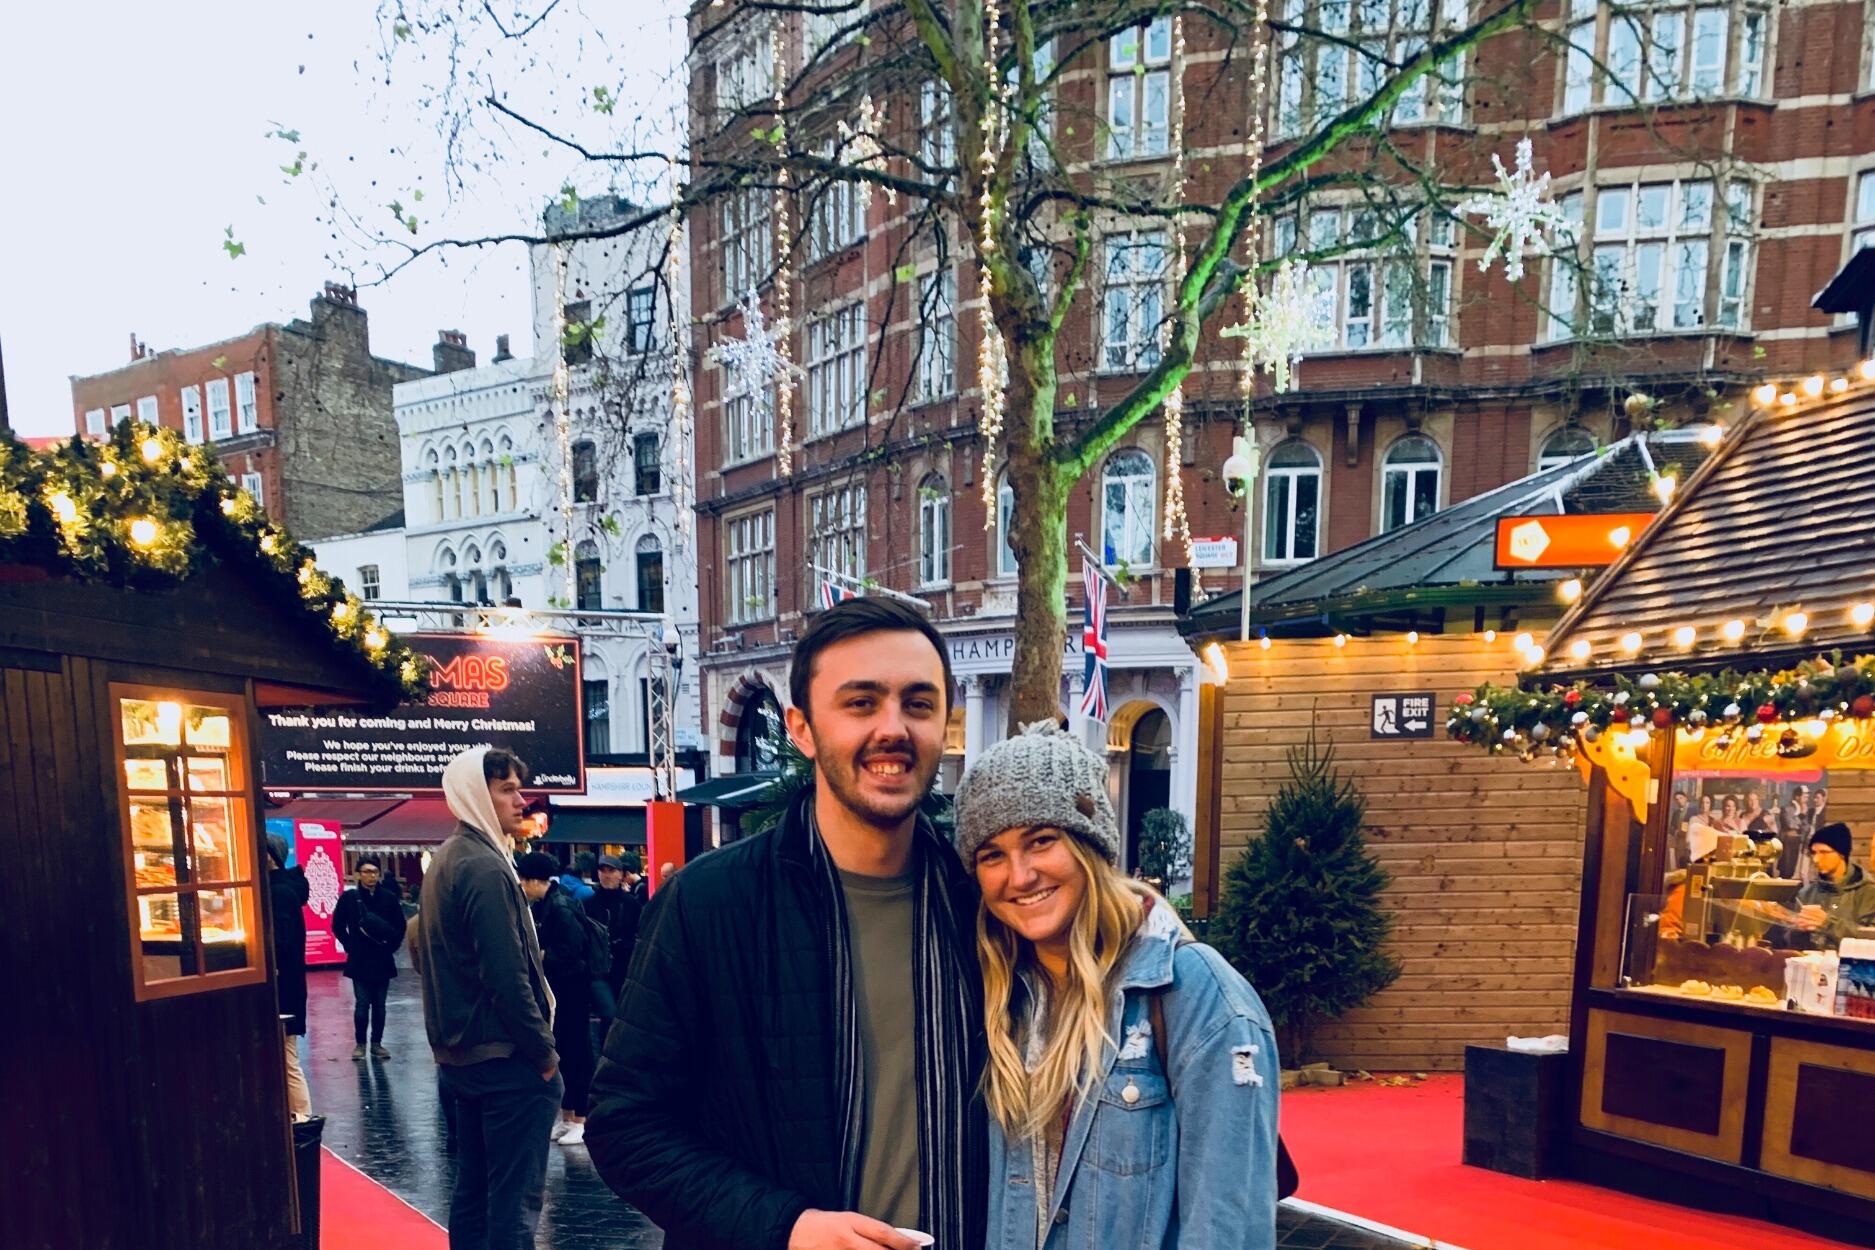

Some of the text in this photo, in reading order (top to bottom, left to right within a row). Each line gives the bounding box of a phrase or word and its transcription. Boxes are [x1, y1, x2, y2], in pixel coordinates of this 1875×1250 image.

[428, 692, 490, 708] SQUARE
[1403, 698, 1429, 707] FIRE
[1402, 708, 1429, 717] EXIT
[268, 714, 536, 732] Thank you for coming and Merry Christmas!
[323, 740, 341, 750] We
[343, 741, 370, 752] hope
[371, 742, 405, 752] you've
[406, 742, 447, 752] enjoyed
[448, 743, 472, 753] your
[1700, 732, 1778, 763] Coffee
[286, 751, 320, 761] Please
[321, 752, 360, 763] respect
[361, 753, 379, 761] our
[380, 752, 436, 763] neighbours
[305, 762, 339, 772] Please
[340, 763, 368, 773] finish
[370, 764, 393, 775] your
[394, 764, 425, 773] drinks
